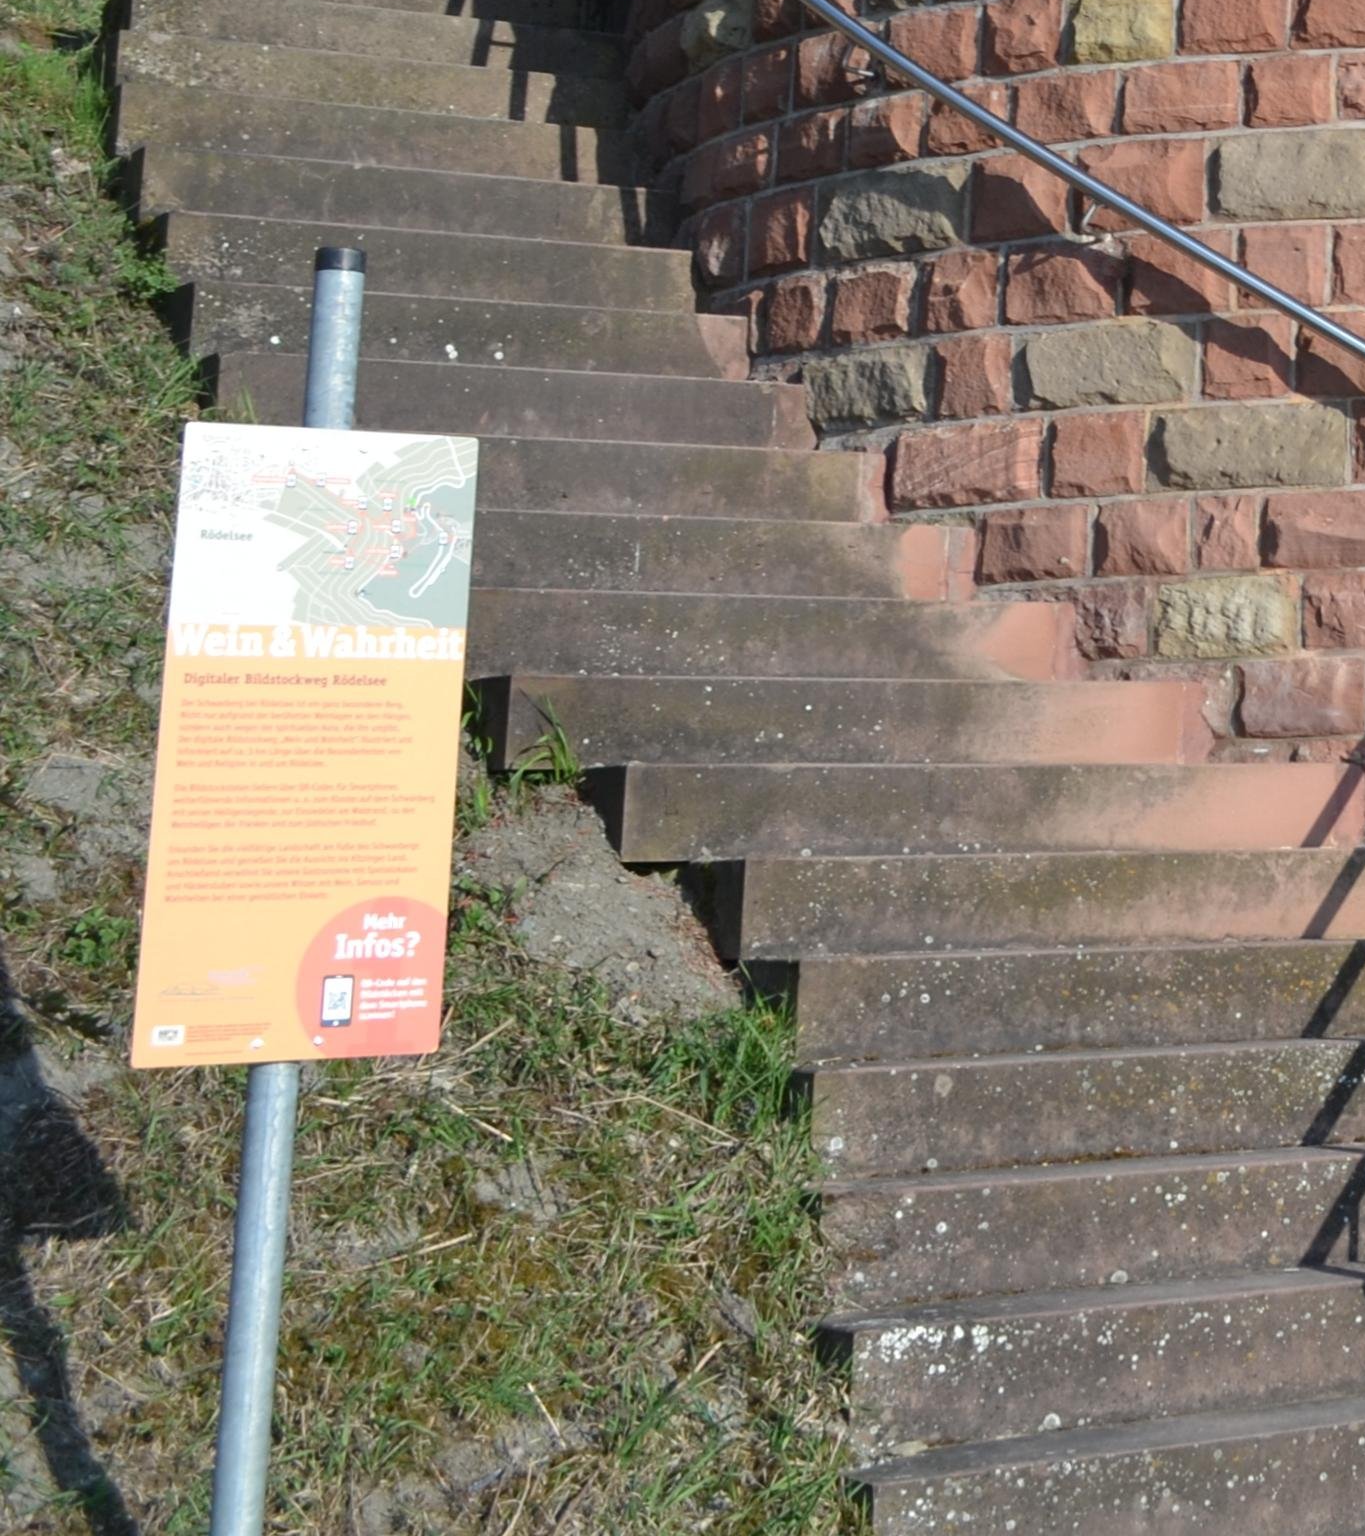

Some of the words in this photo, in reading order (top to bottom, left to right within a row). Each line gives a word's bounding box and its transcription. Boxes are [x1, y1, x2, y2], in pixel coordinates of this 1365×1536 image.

[200, 528, 254, 541] Rödelsee
[171, 623, 264, 658] Wein
[269, 624, 296, 658] &
[302, 625, 464, 661] Wahrheit
[184, 672, 240, 687] Digitaler
[245, 673, 328, 688] Bildstockweg
[333, 674, 388, 687] Rödelsee
[363, 912, 407, 931] Mehr
[334, 931, 422, 960] Infos?
